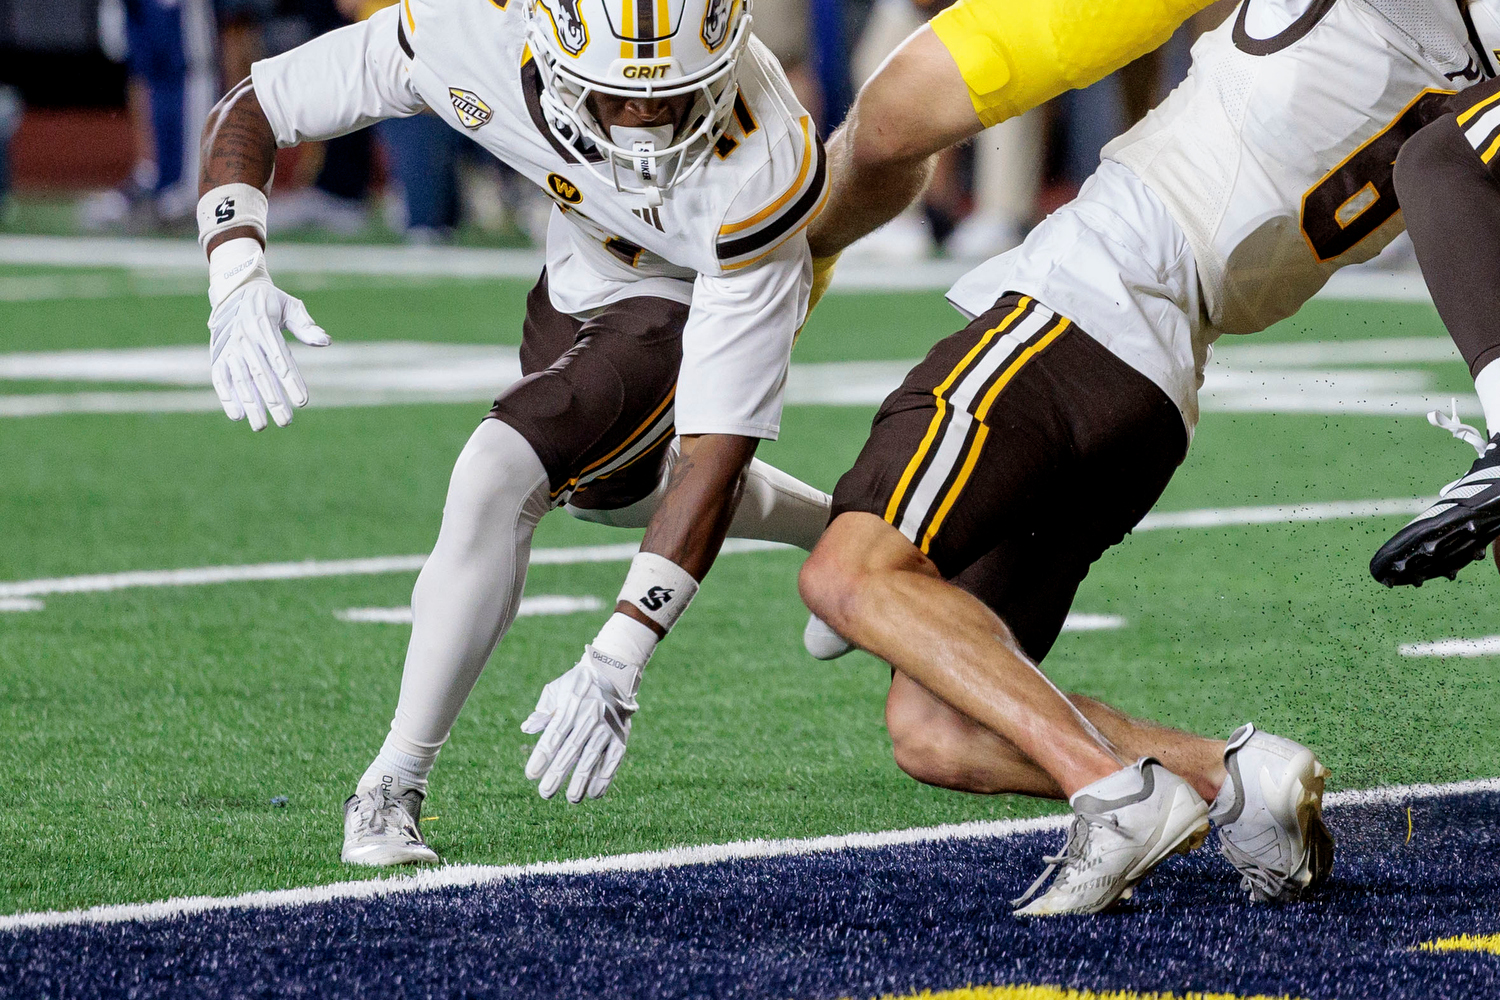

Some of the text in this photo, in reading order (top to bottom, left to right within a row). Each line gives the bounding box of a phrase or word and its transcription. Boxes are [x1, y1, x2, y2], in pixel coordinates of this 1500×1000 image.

[622, 63, 671, 79] GRIT
[553, 176, 577, 199] W
[592, 651, 628, 670] ADIZERO
